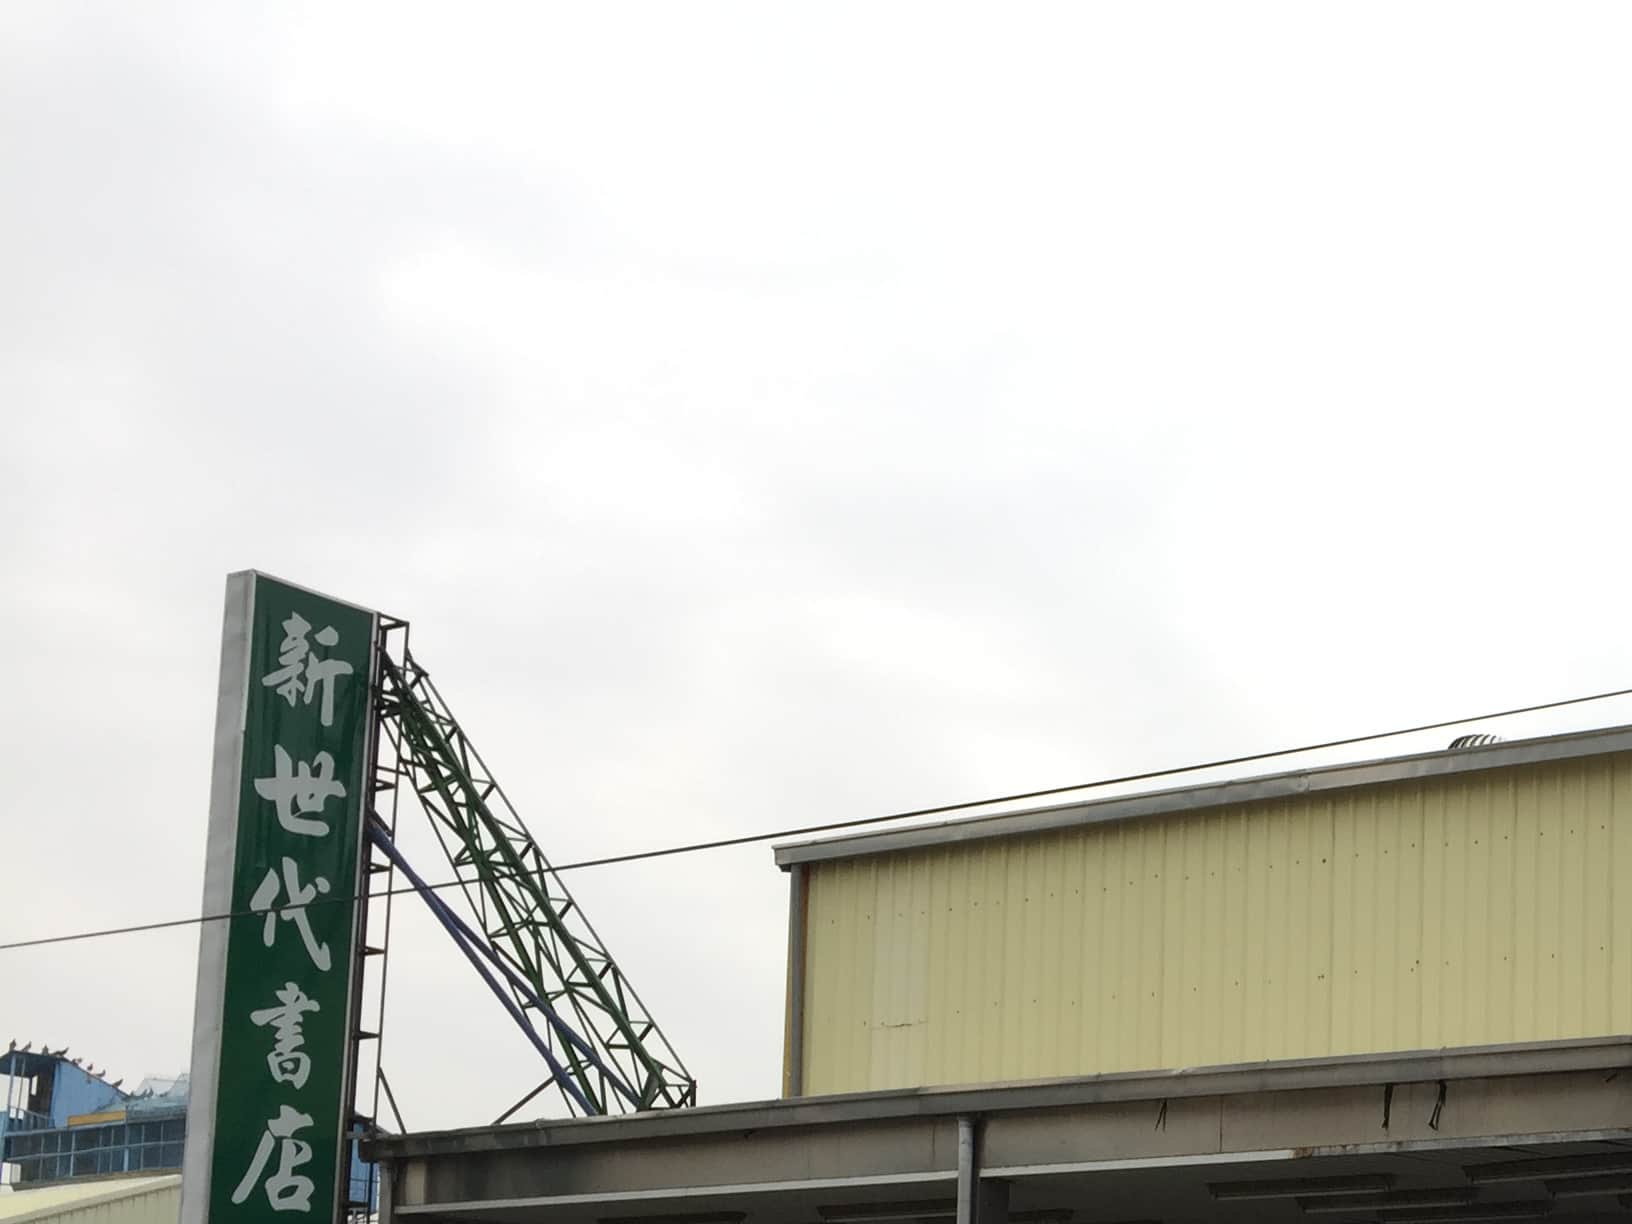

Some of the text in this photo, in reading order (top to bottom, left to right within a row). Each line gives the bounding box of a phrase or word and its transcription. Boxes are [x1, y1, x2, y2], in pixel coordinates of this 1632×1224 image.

[230, 610, 354, 1214] 新世代書店
